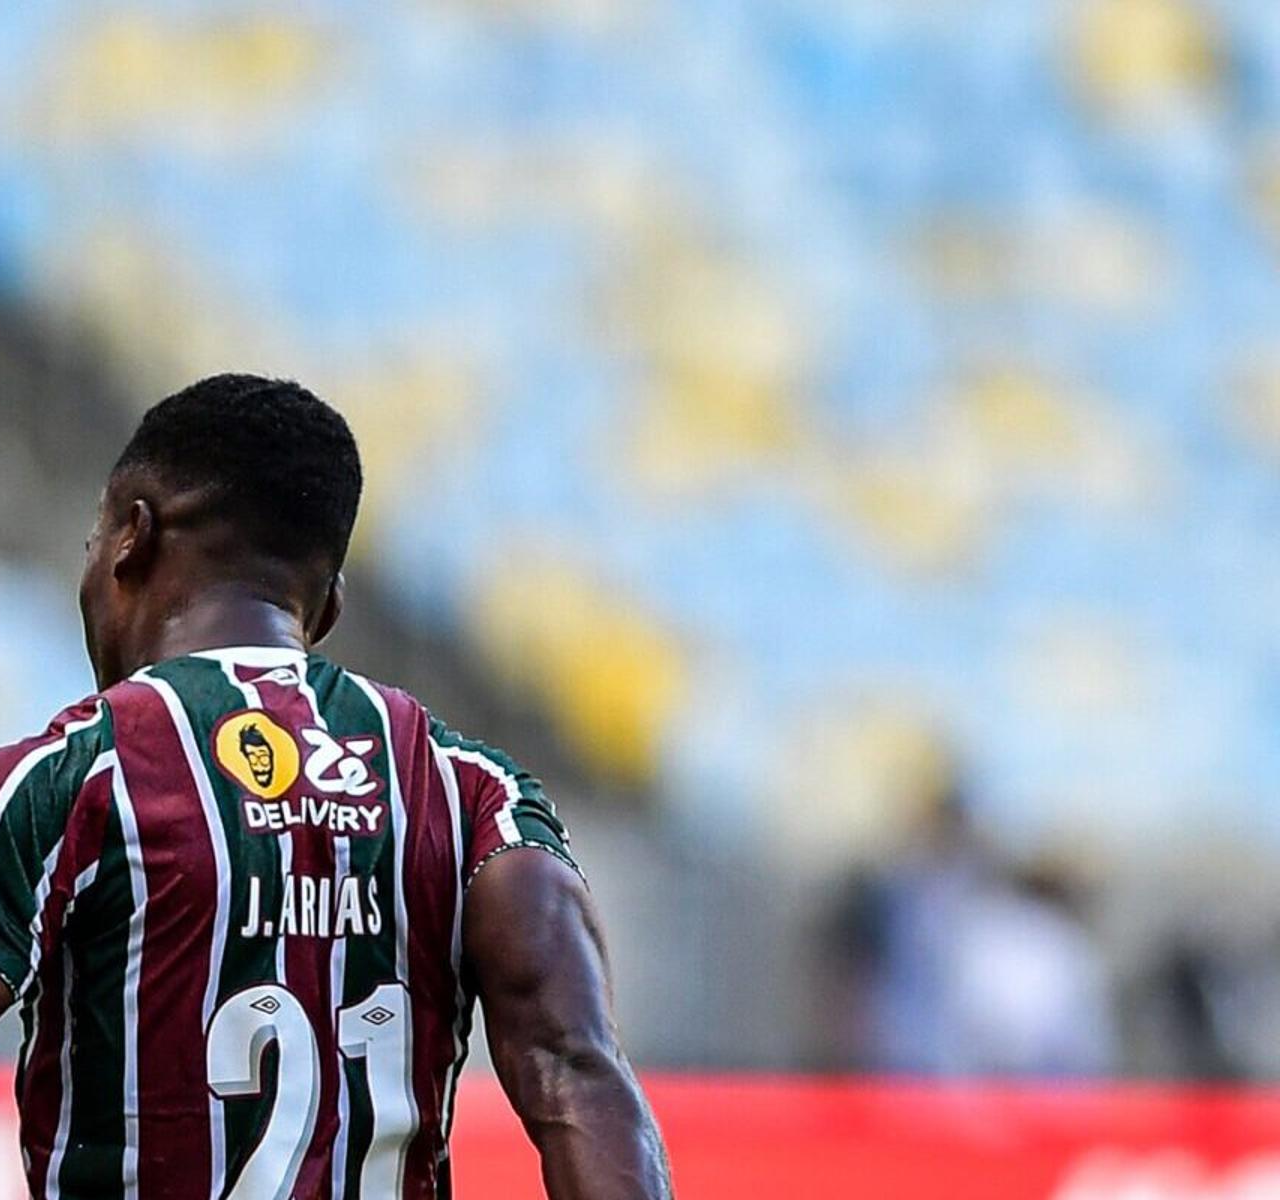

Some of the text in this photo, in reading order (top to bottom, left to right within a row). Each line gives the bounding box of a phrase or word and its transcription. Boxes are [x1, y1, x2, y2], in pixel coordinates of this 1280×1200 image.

[301, 728, 377, 796] Zé
[244, 796, 382, 831] DELIVERY
[241, 874, 382, 938] J.ARIAS
